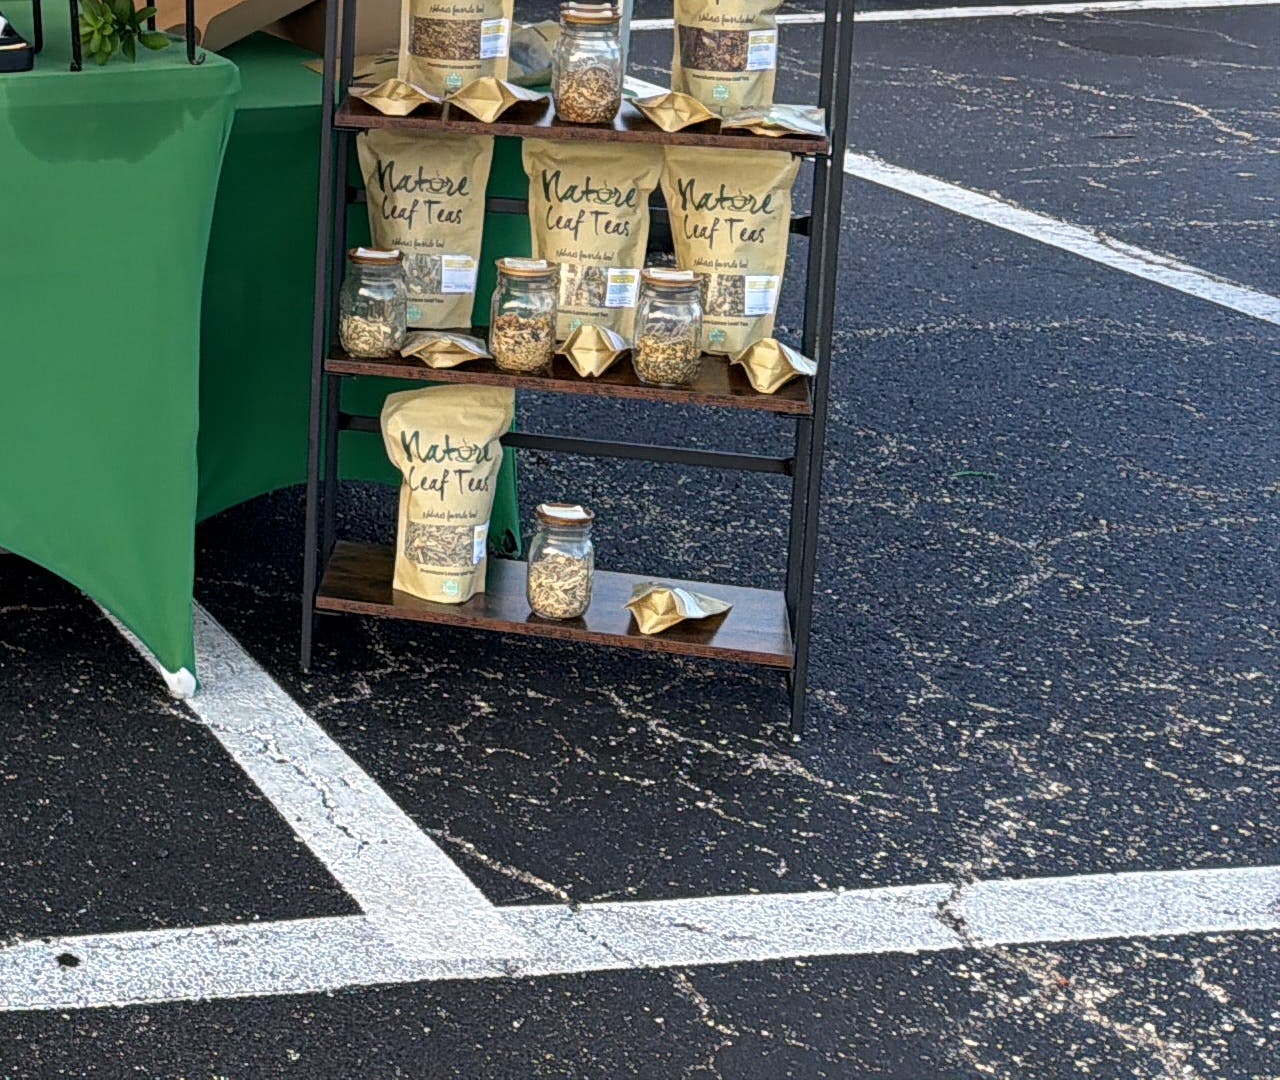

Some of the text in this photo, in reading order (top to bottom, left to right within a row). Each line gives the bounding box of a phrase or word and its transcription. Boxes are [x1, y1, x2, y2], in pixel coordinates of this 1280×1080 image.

[377, 160, 469, 196] Nature
[541, 169, 636, 207] Nature
[382, 197, 462, 230] Leaf Teas
[677, 178, 775, 215] Nature
[546, 206, 630, 241] Leaf Teas
[683, 214, 766, 249] Leaf Teas
[409, 466, 449, 501] Leaf
